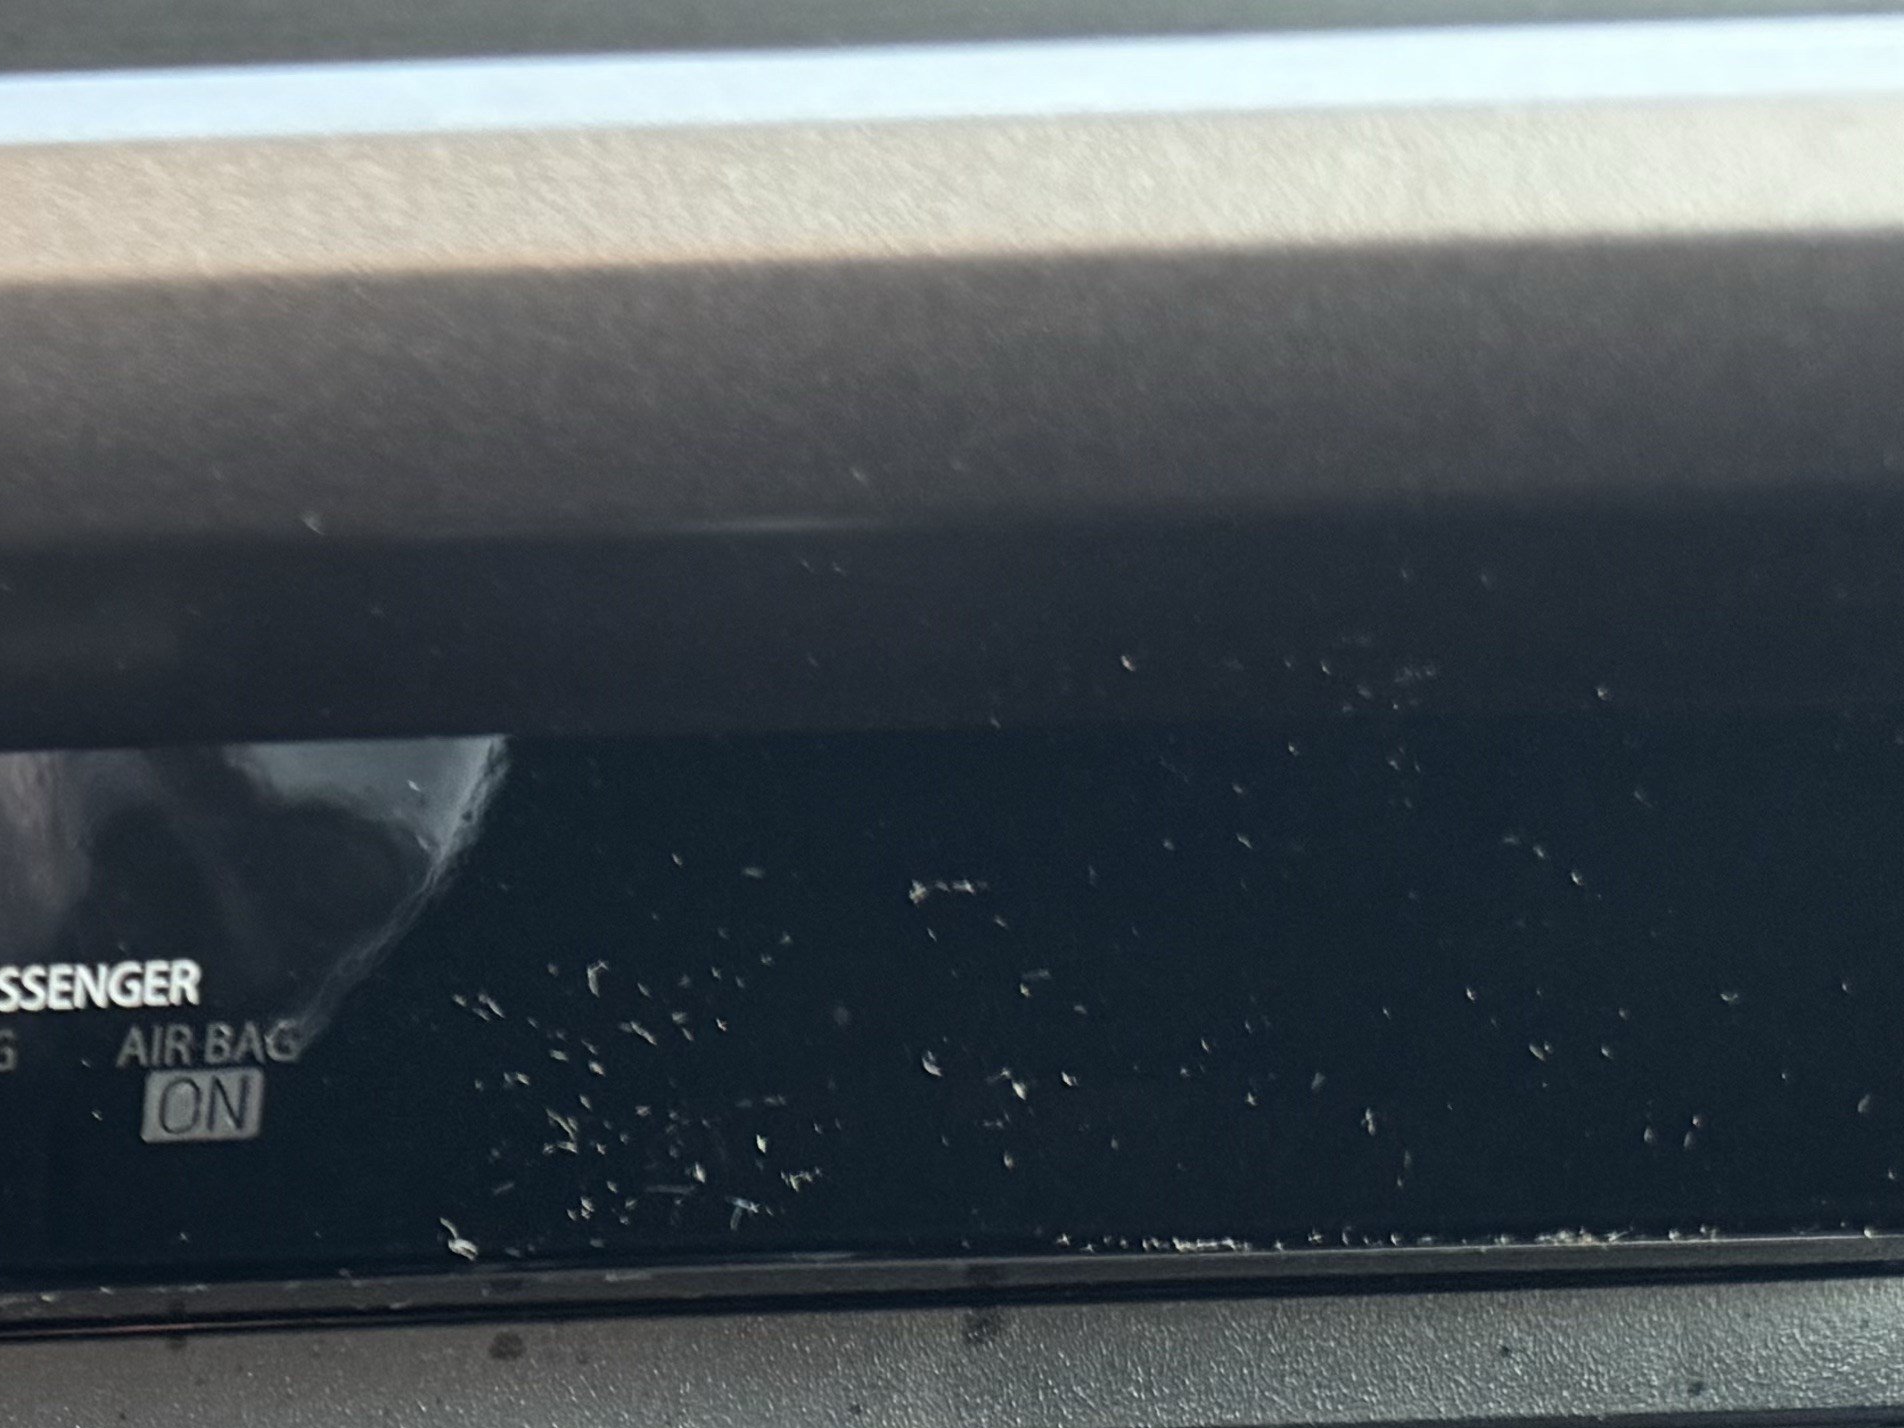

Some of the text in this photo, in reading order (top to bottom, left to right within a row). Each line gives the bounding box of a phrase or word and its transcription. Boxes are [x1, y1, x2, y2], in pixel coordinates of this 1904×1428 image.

[116, 1018, 302, 1069] AIR BAG
[158, 1074, 252, 1136] ON
